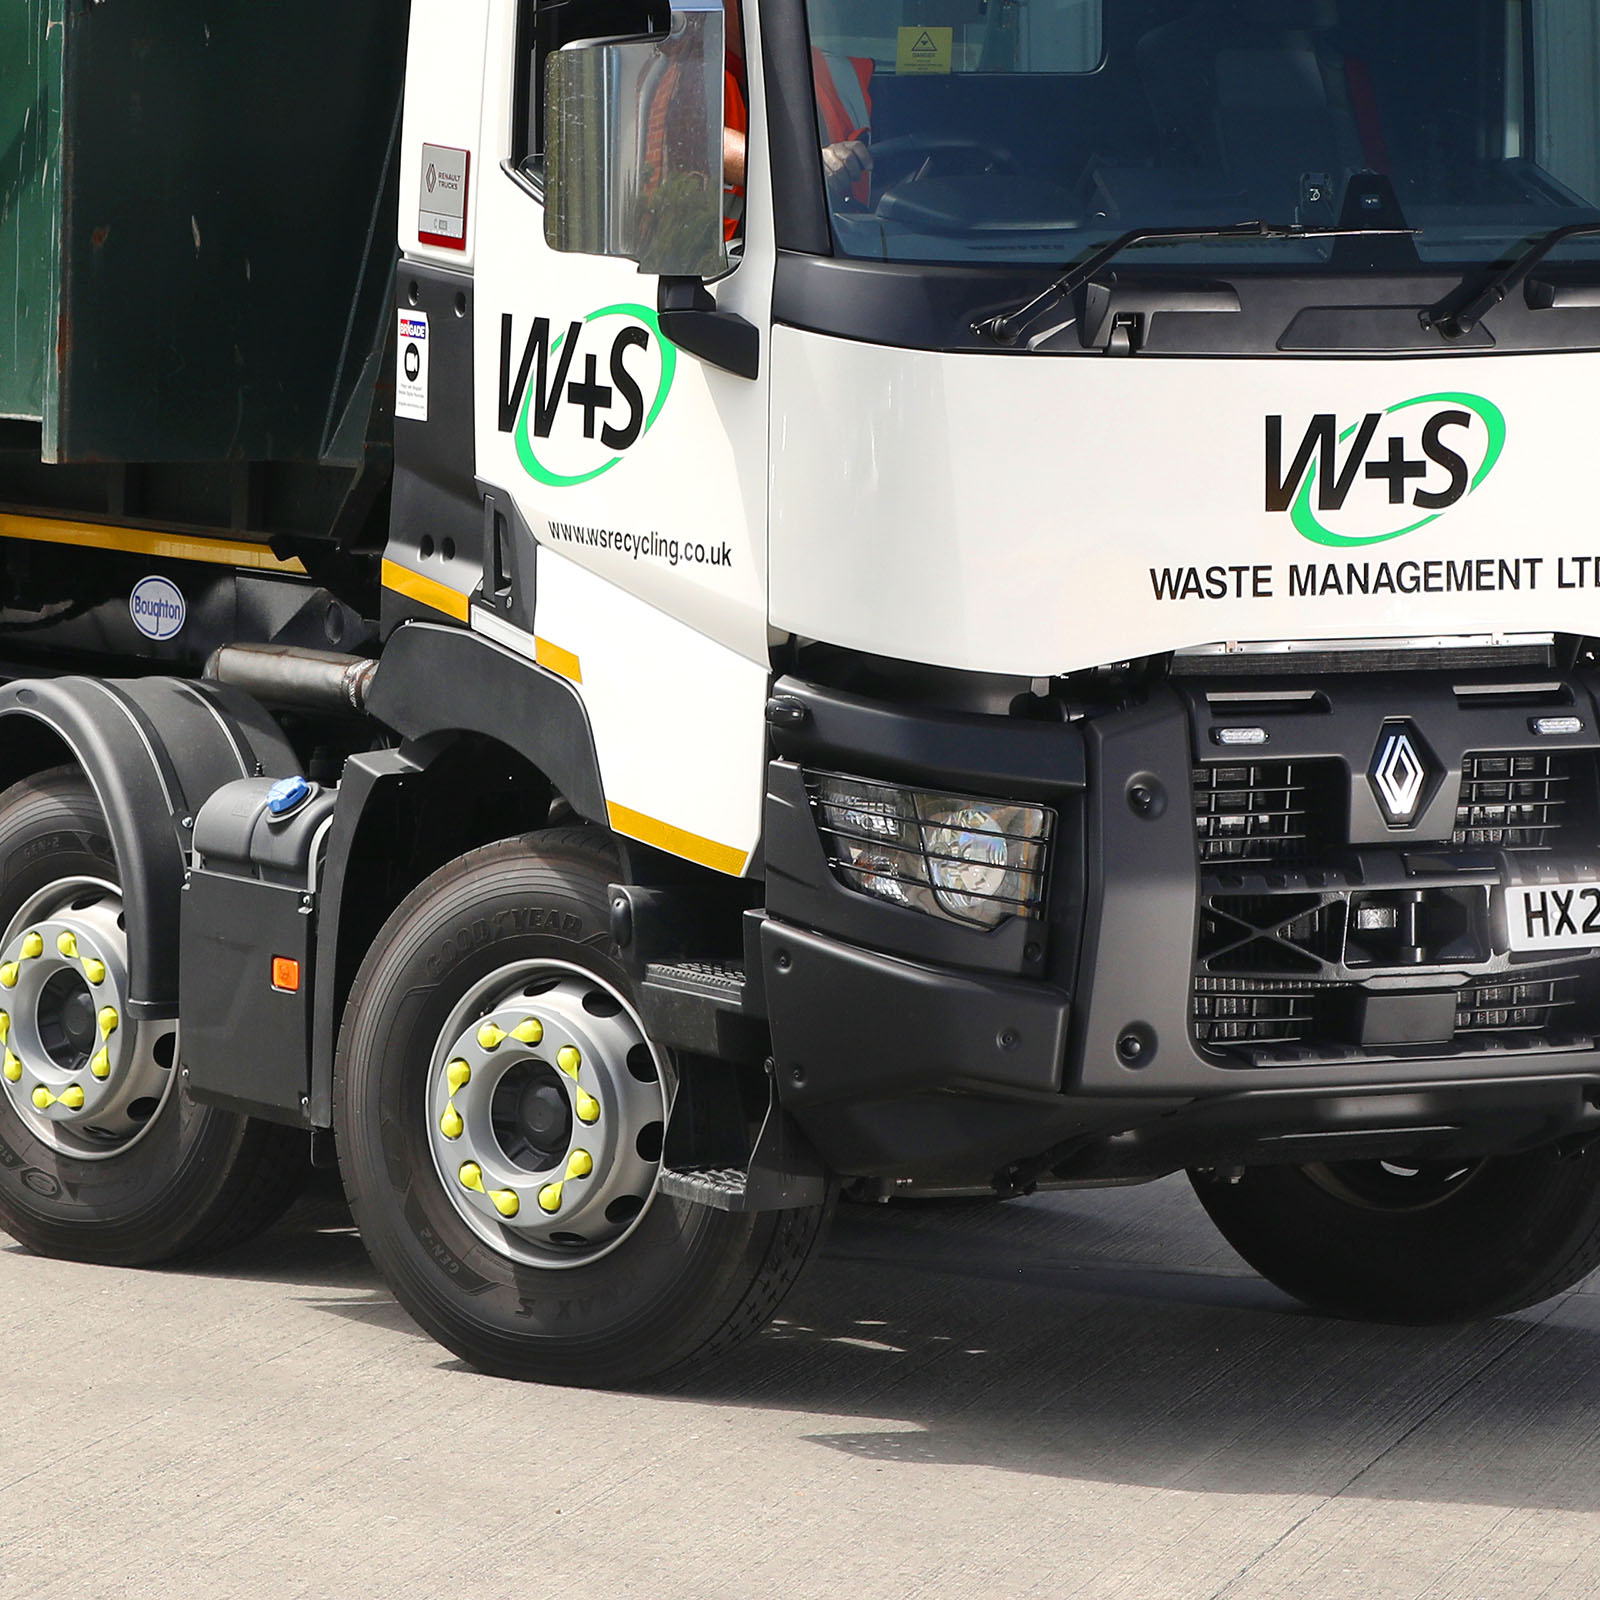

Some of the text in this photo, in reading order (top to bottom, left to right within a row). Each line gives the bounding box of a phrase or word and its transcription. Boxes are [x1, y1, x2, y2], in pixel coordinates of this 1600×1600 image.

[438, 172, 461, 183] RENAULT
[438, 180, 458, 191] TRUCKS
[400, 321, 426, 339] BRIGADE
[498, 313, 649, 451] W+S
[1264, 410, 1471, 512] W+S
[548, 520, 732, 568] www.wsrecycling.co.uk
[1149, 566, 1273, 601] WASTE
[1289, 558, 1544, 597] MANAGEMENT
[135, 595, 181, 621] Boughton
[420, 1227, 460, 1274] GEN-2
